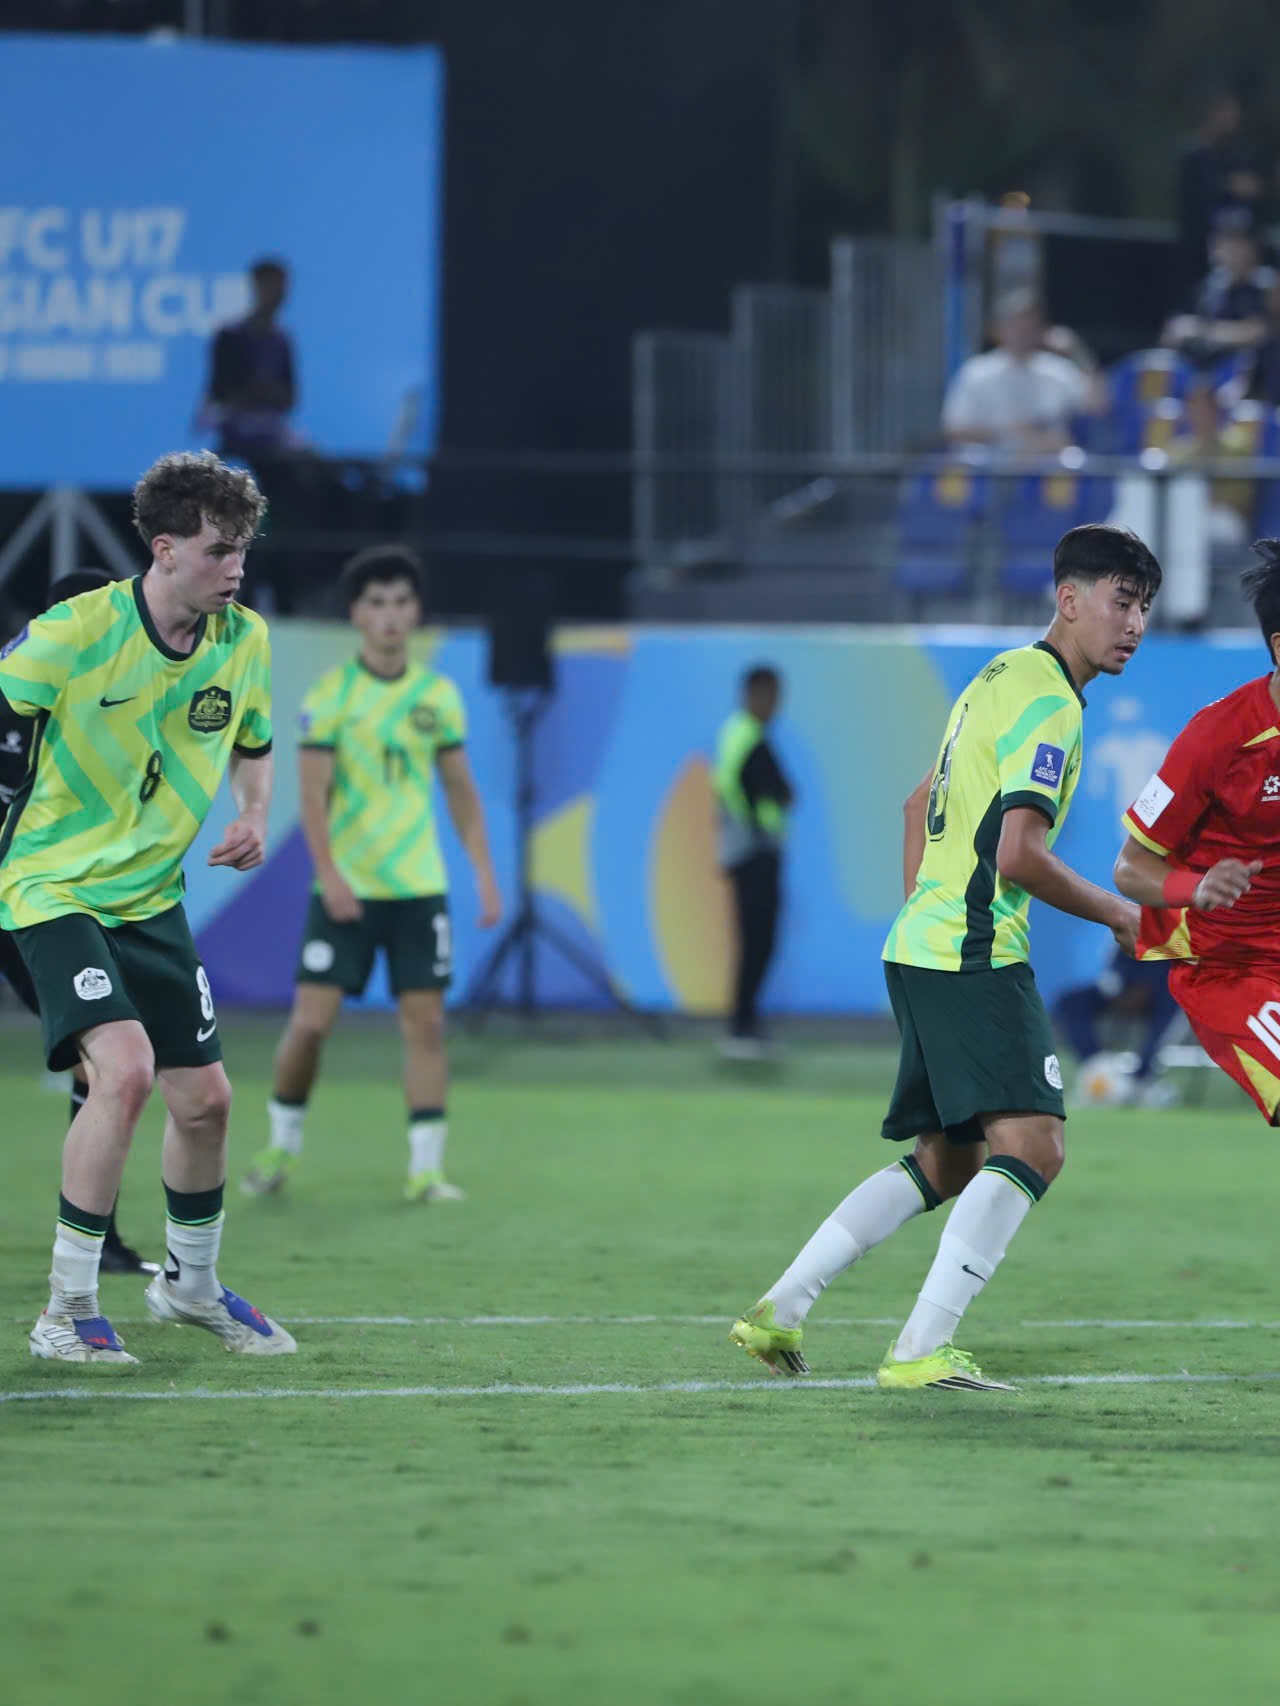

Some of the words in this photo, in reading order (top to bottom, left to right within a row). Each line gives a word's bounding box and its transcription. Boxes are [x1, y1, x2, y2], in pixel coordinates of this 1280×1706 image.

[80, 207, 187, 271] U17
[139, 750, 163, 804] 8
[196, 966, 214, 1021] 8
